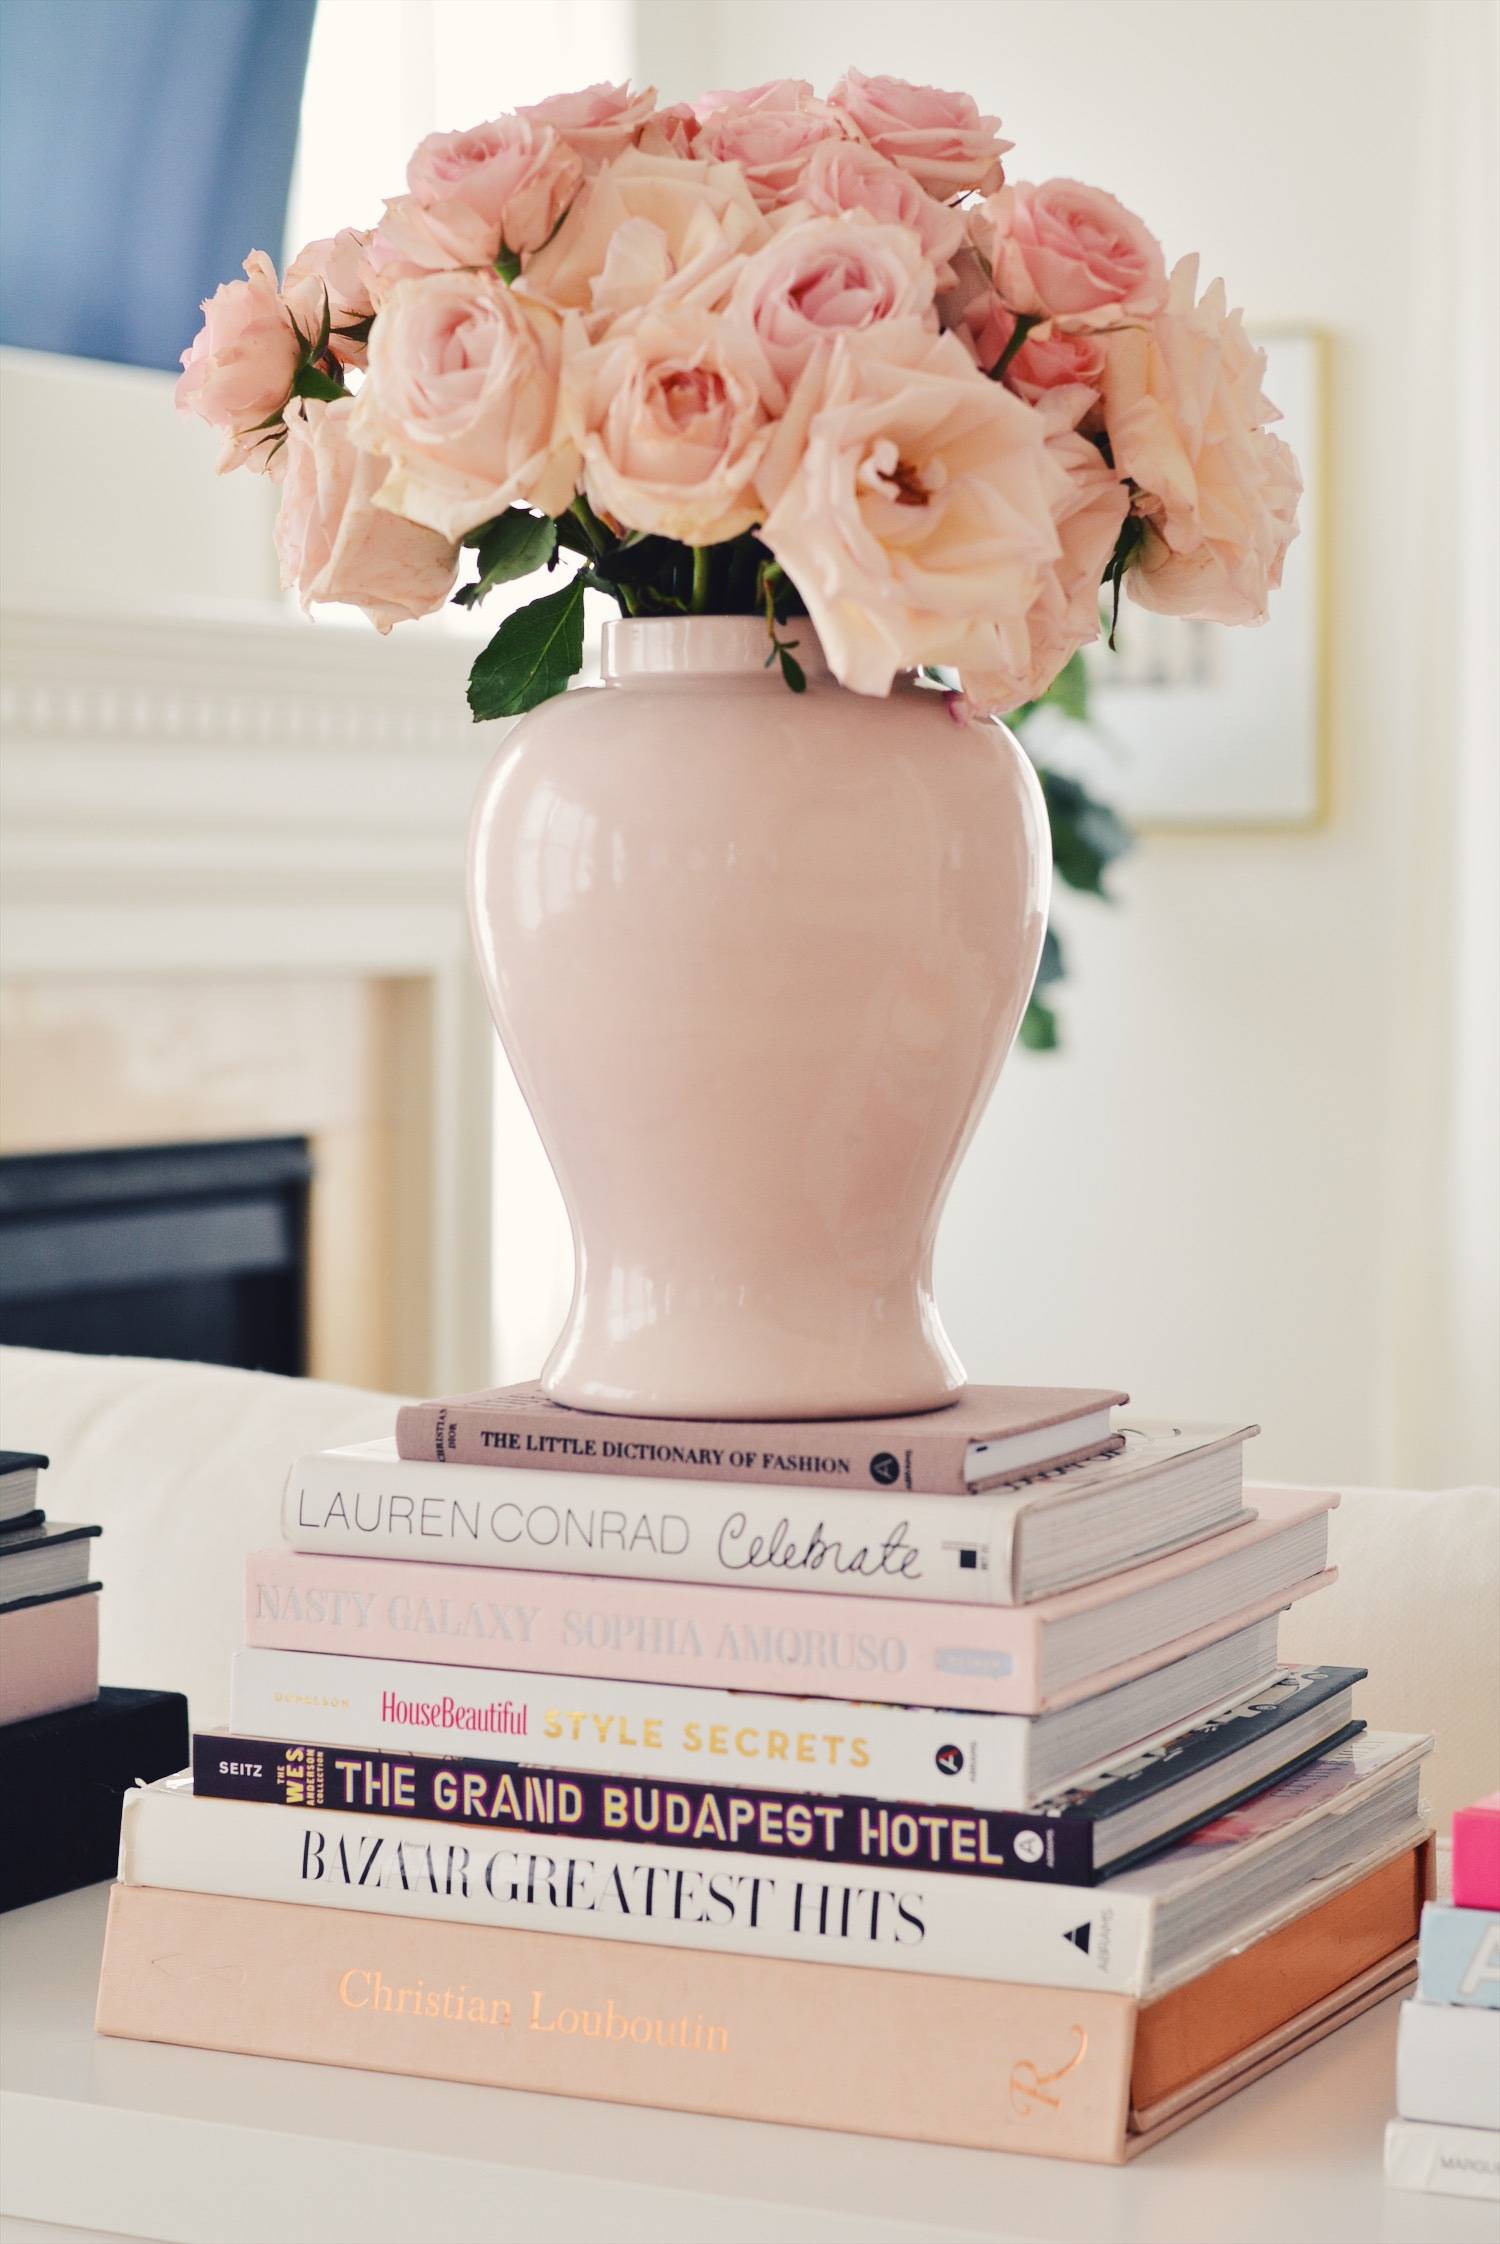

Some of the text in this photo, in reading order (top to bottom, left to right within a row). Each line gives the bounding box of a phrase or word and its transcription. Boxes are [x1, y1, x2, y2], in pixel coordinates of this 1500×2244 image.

[448, 1423, 457, 1449] DIOR
[481, 1431, 850, 1474] THE LITTLE DICTIONARY OF FASHION
[299, 1489, 690, 1556] LAUREN CONRAD
[718, 1512, 922, 1580] Celebrate
[255, 1583, 908, 1674] NASTY GALAXY SOPHIA AMORUSO
[219, 1761, 262, 1777] SEITZ
[544, 1708, 663, 1750] STYLE
[683, 1725, 872, 1769] SECRETS
[277, 1766, 285, 1784] THE
[286, 1747, 304, 1803] WES
[306, 1749, 315, 1806] ANDERSON
[335, 1759, 1004, 1865] THE GRAND BUDAPEST HOTEL
[300, 1829, 926, 1946] BAZAAR GREATEST HITS
[338, 1967, 730, 2055] Christian Louboutin
